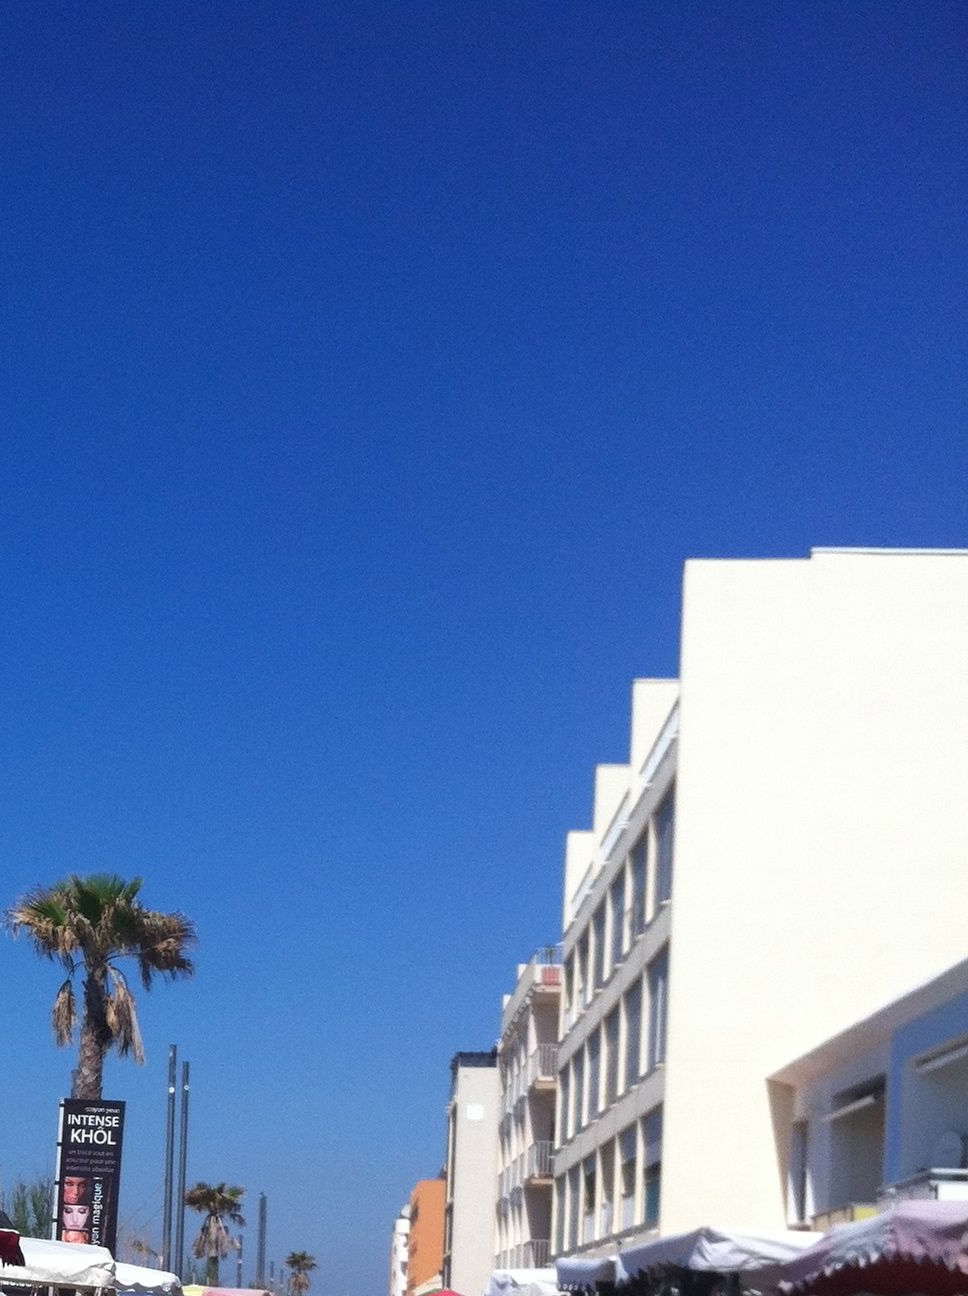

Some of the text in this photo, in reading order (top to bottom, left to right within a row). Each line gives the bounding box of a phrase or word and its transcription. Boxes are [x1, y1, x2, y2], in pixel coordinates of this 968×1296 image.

[68, 1114, 119, 1127] INTENSE
[71, 1126, 116, 1145] KHÔL
[92, 1183, 103, 1224] magique
